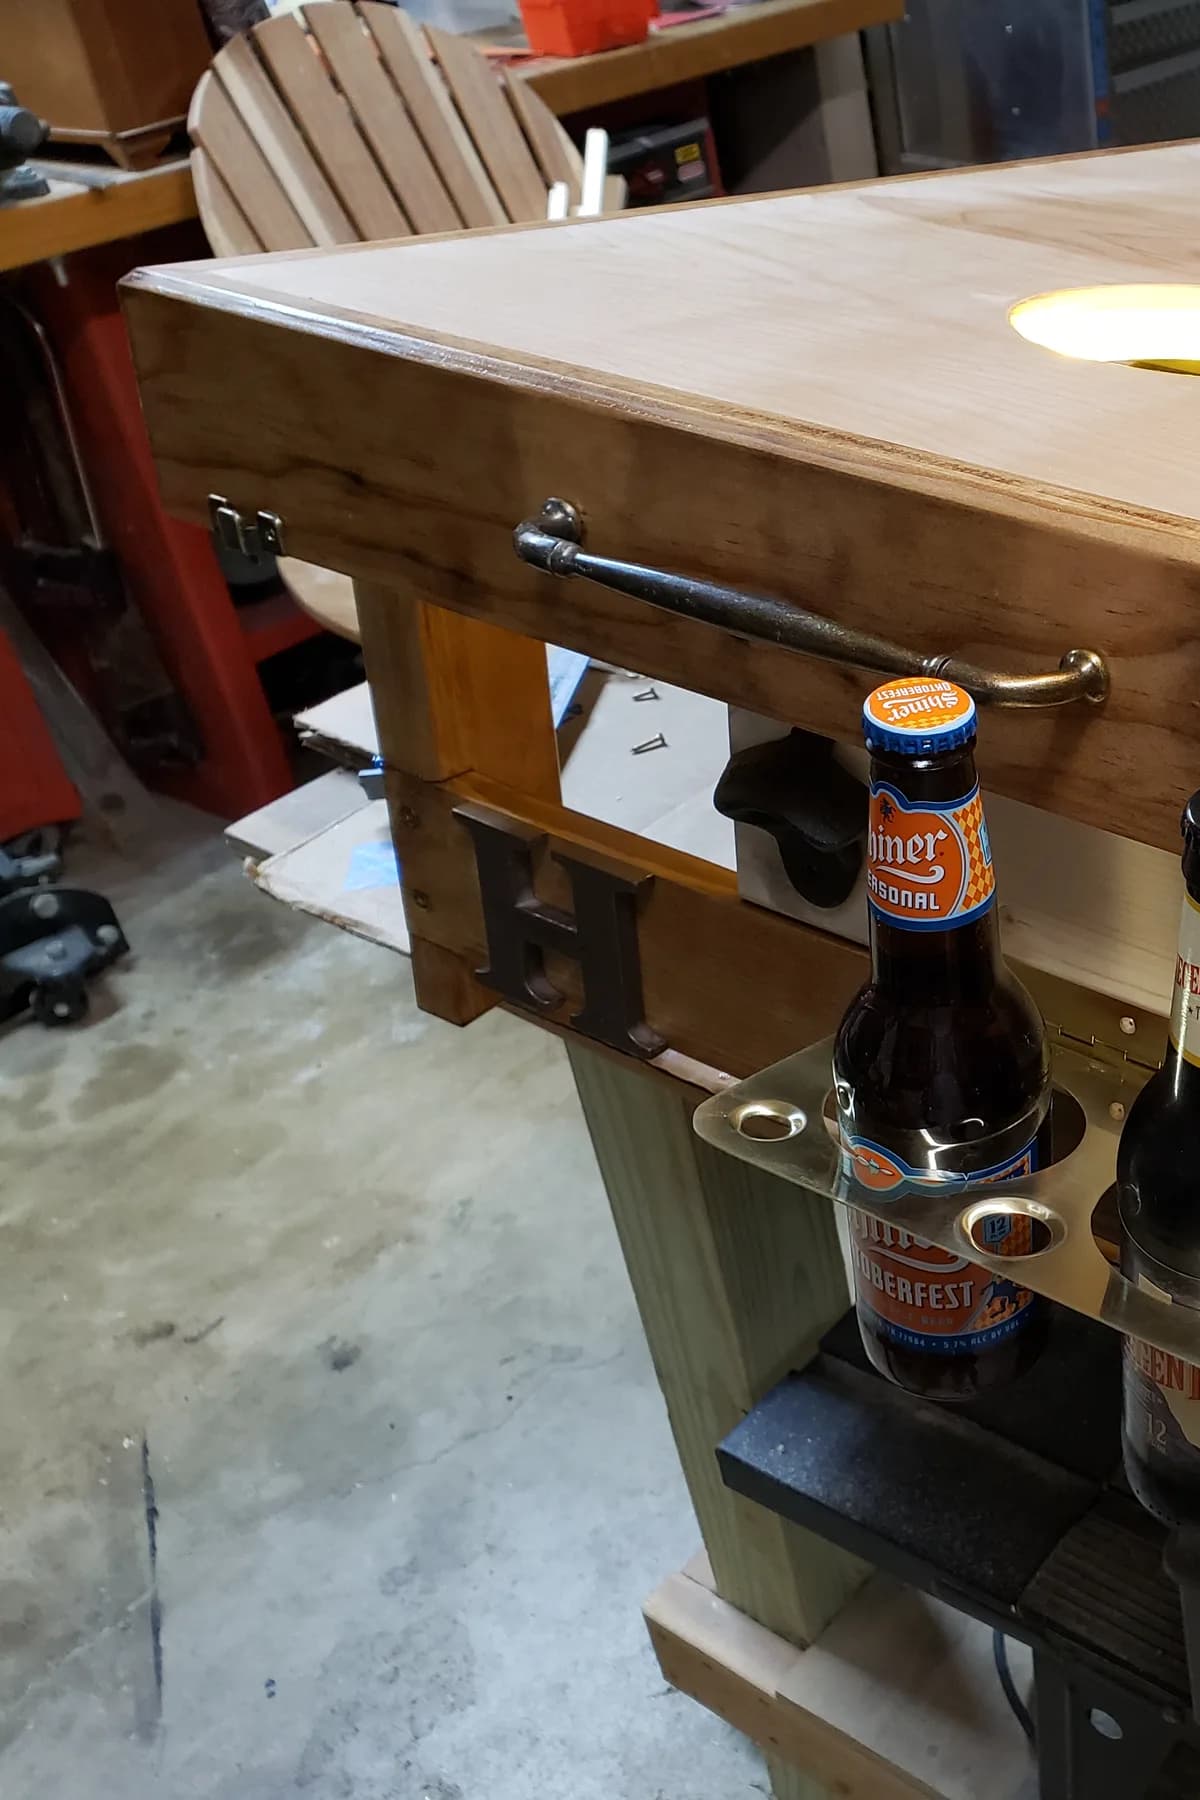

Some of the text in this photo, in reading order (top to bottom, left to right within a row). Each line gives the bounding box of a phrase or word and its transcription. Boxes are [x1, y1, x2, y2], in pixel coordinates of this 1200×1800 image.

[876, 681, 952, 700] OKTOBERFEST
[886, 691, 959, 722] Shiner
[1144, 1411, 1167, 1446] 12
